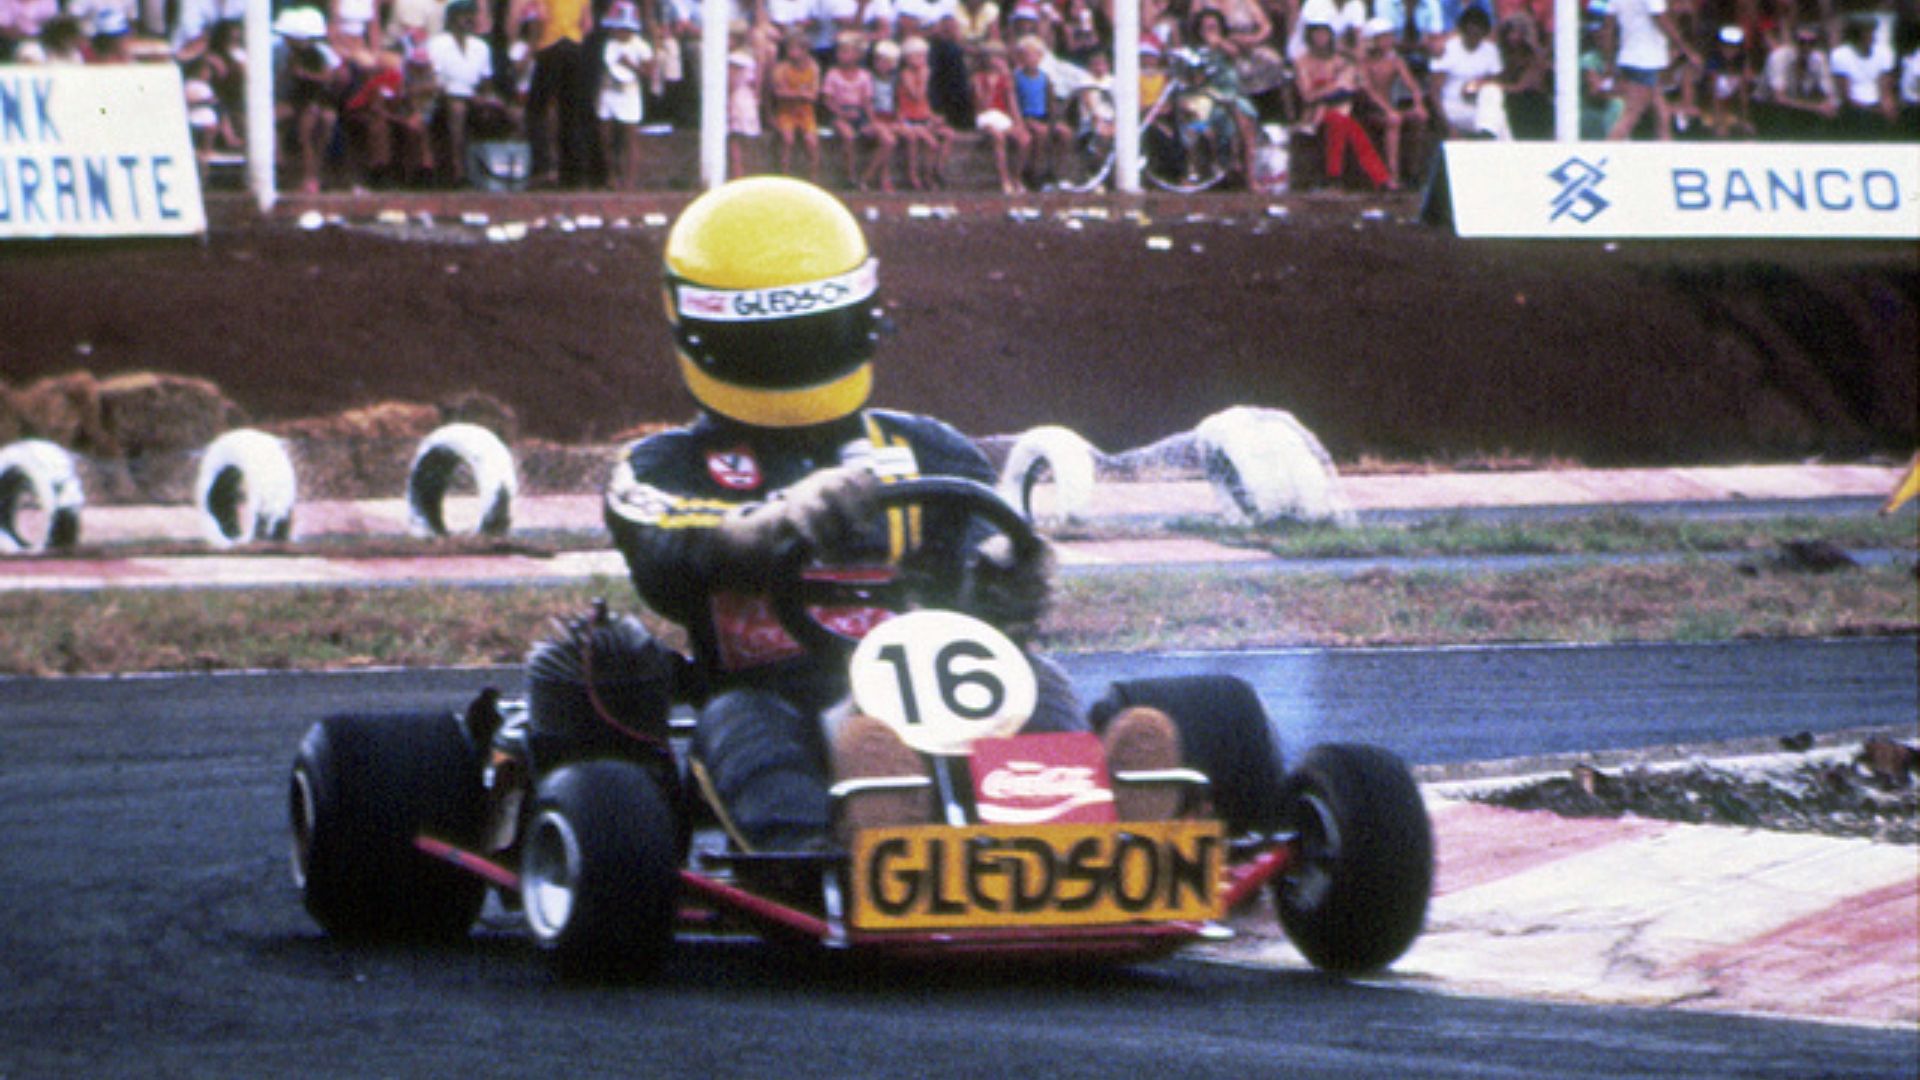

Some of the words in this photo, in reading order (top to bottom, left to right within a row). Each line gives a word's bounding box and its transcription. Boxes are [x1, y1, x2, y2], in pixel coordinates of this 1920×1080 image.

[1671, 167, 1901, 211] BANCO
[876, 639, 1006, 724] 16
[868, 833, 1221, 916] GLEDSON
